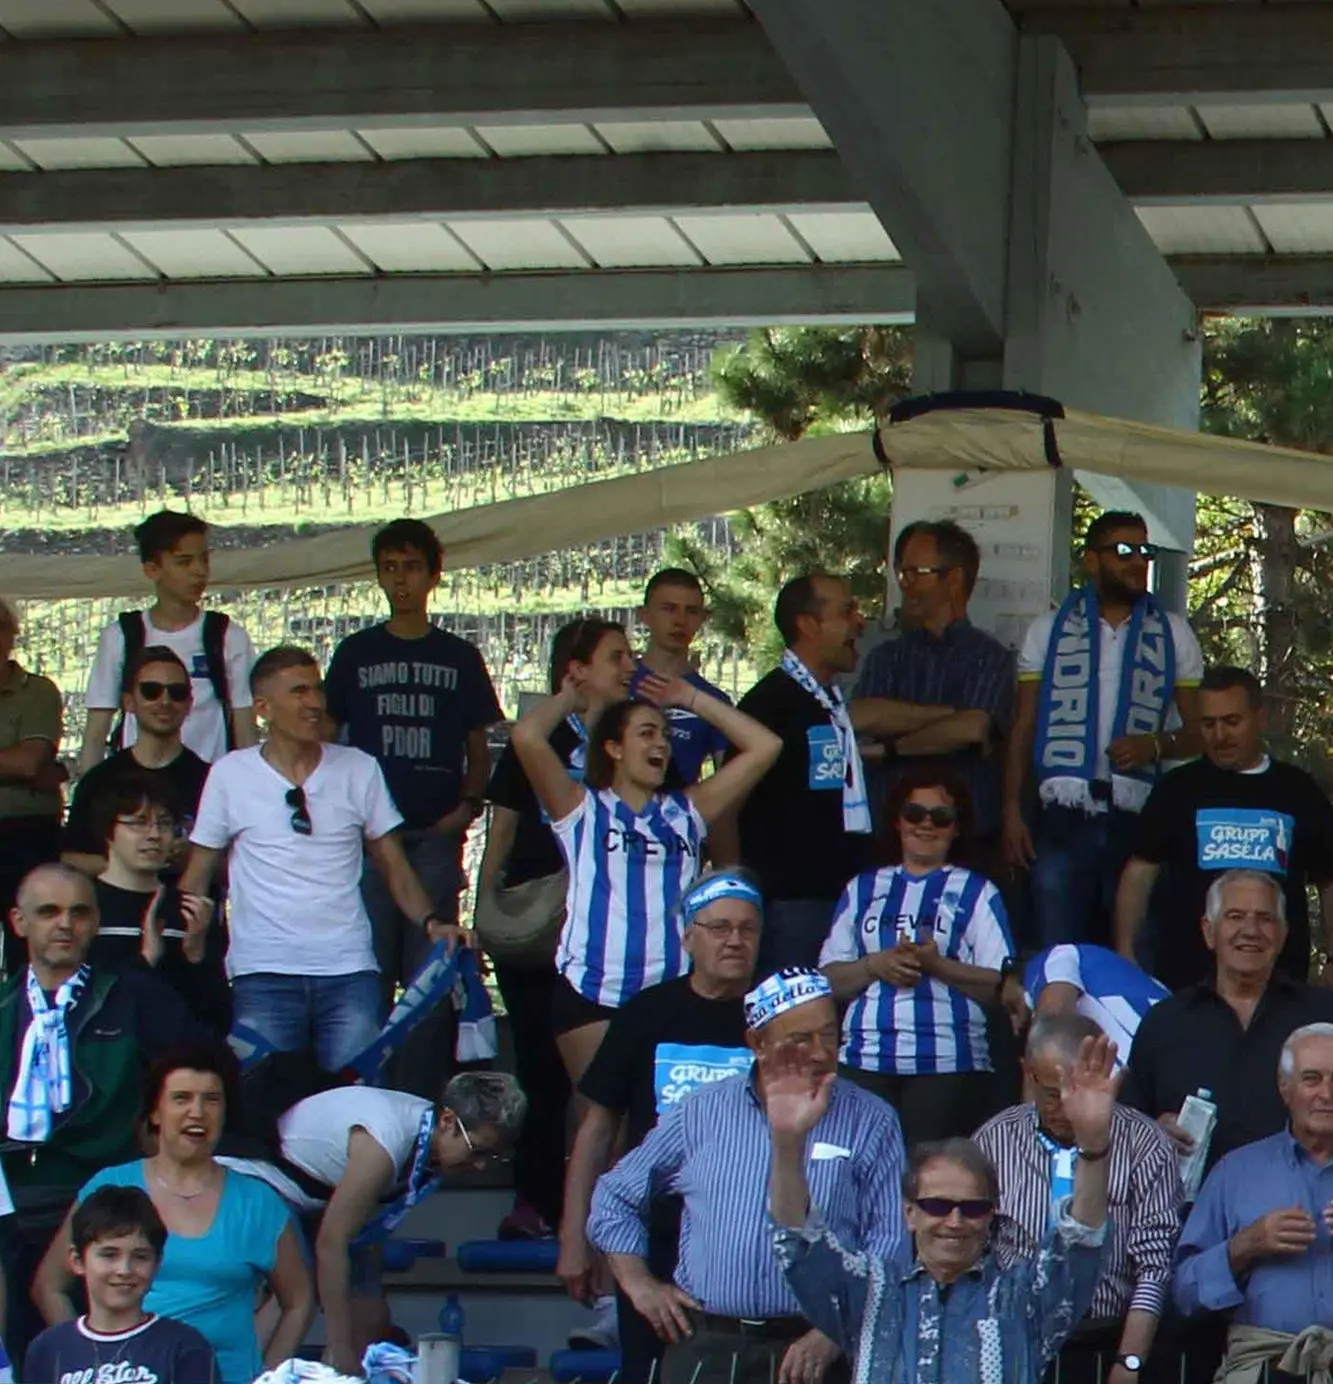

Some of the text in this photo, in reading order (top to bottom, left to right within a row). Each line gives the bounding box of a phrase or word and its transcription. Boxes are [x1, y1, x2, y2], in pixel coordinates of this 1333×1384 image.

[358, 661, 458, 690] SIAMO TUTTI
[377, 693, 435, 717] FIGLI DI
[382, 725, 431, 758] PDOR
[1211, 825, 1270, 842] GRUPP
